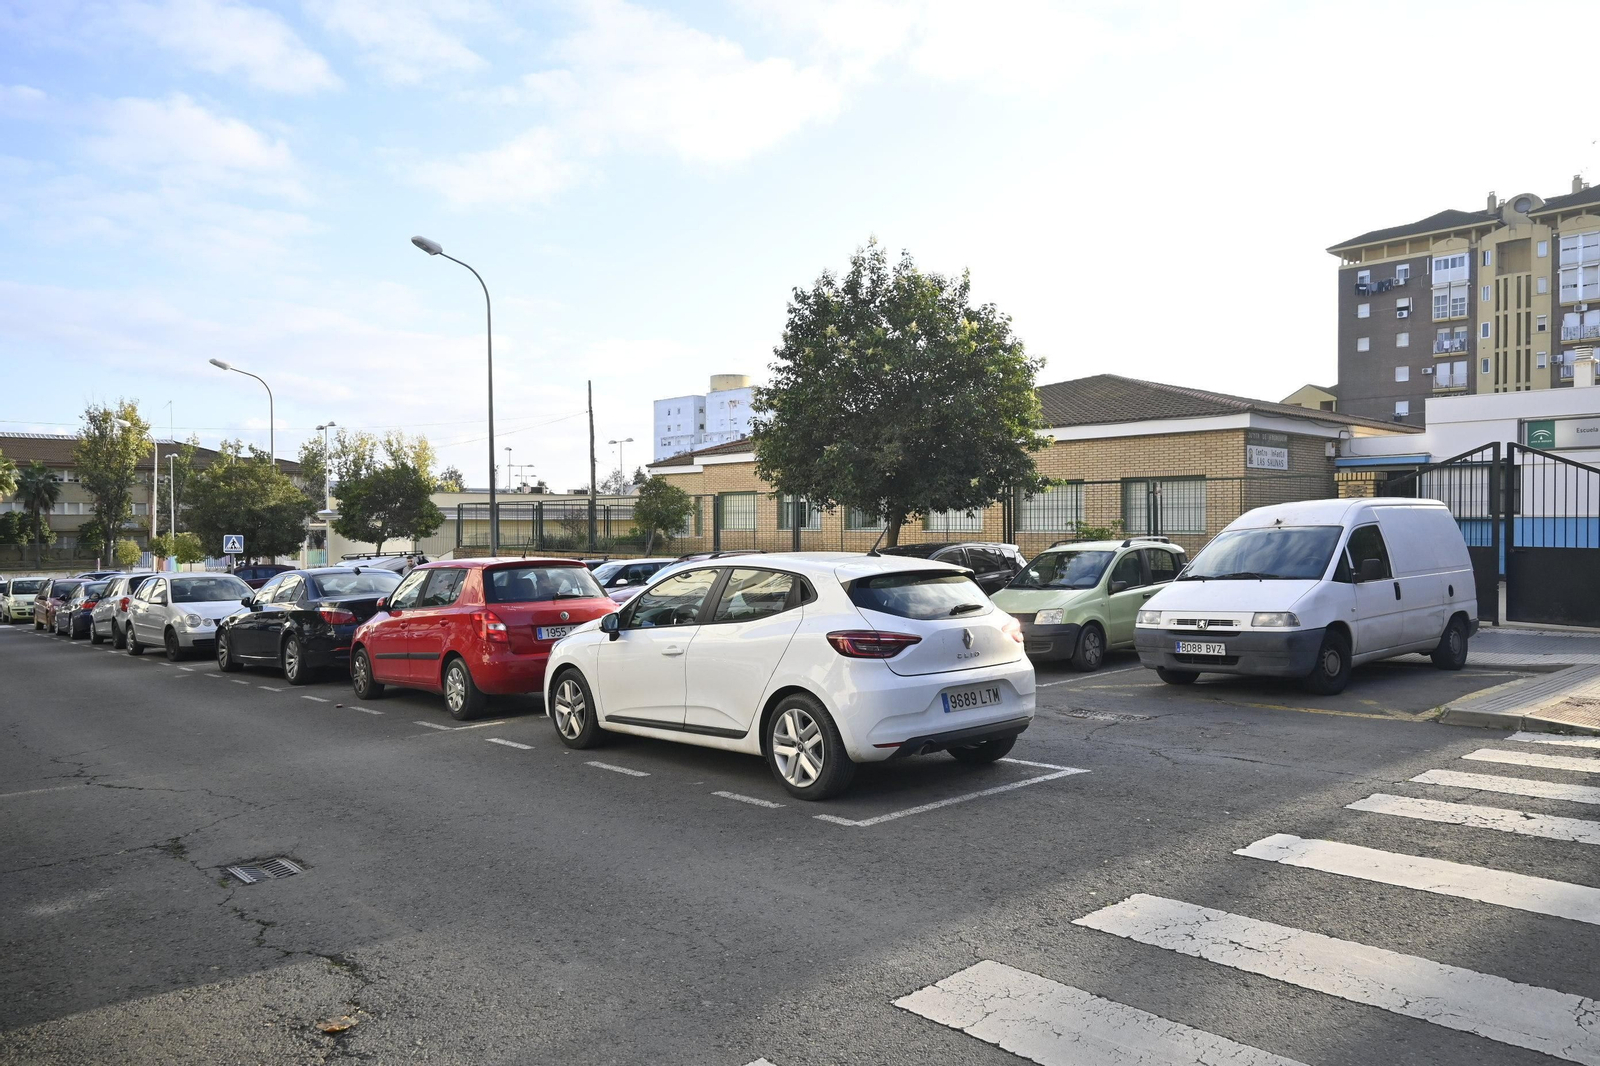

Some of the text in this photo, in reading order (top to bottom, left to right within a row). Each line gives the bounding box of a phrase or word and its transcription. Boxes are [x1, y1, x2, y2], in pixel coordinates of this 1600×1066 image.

[1256, 457, 1266, 466] LAS
[546, 627, 567, 638] 1955
[1205, 644, 1222, 654] BVZ
[957, 651, 980, 659] CLIO
[950, 687, 1000, 709] 9689 LTM
